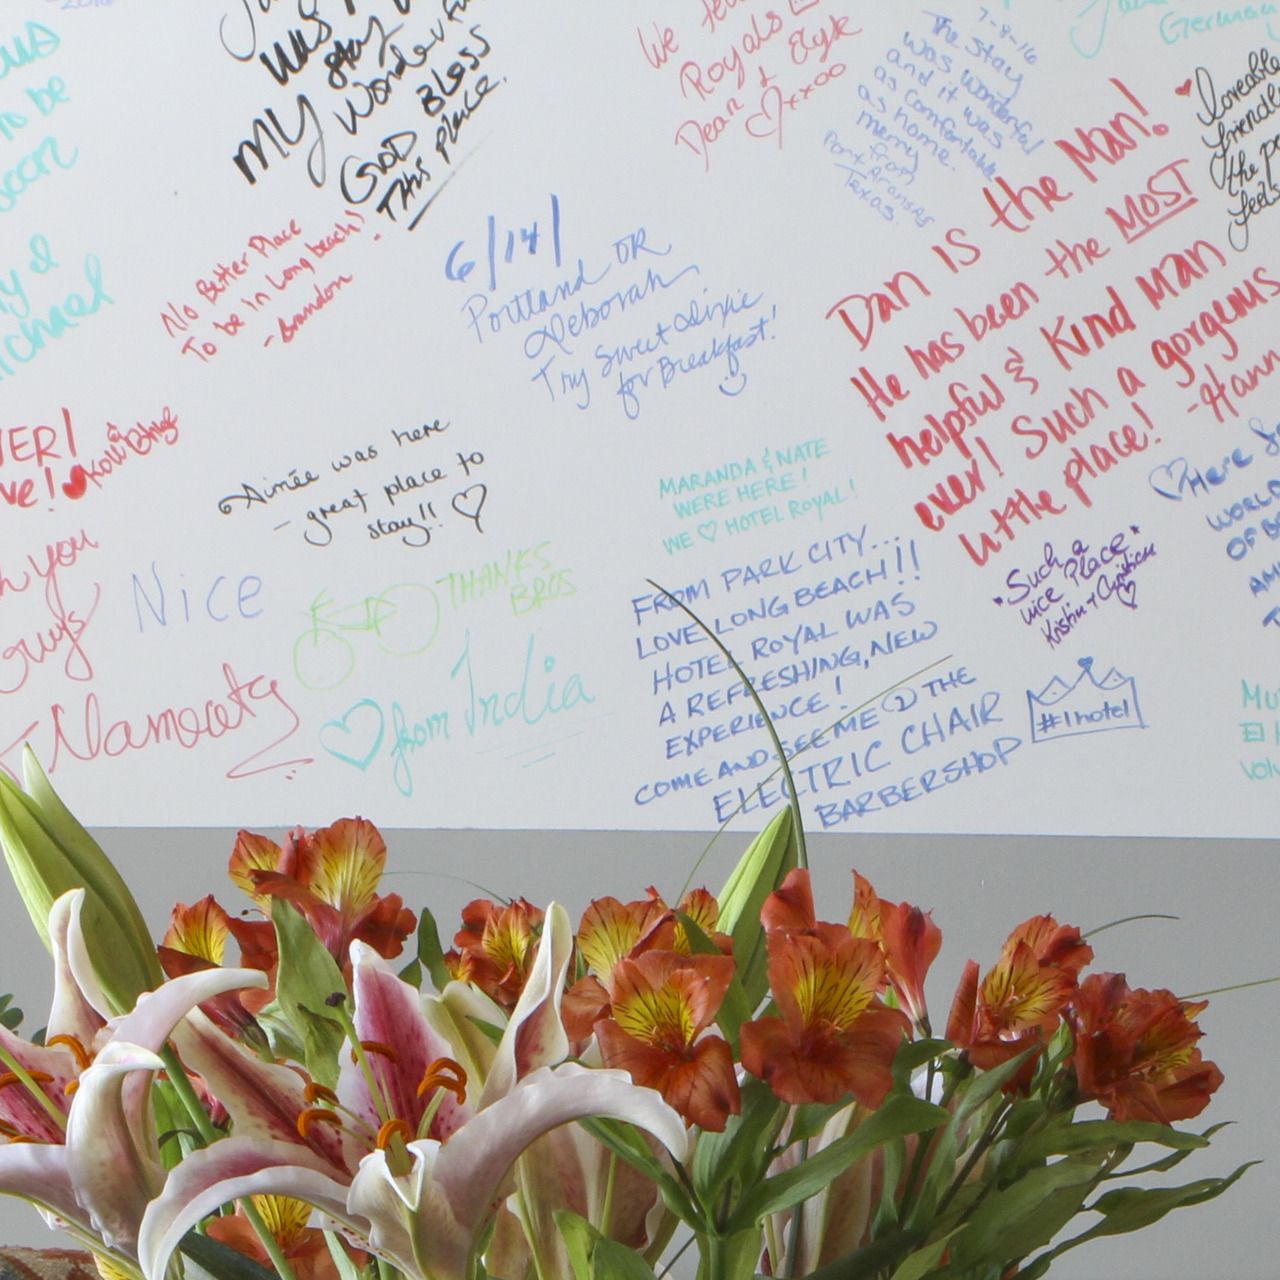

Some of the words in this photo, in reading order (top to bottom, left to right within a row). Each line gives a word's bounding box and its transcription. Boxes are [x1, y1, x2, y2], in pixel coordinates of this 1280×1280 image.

[827, 269, 931, 352] Dan
[983, 174, 1072, 232] the
[1053, 77, 1169, 182] Man!
[160, 302, 199, 338] No
[181, 336, 217, 362] To
[212, 313, 245, 336] be
[851, 365, 910, 422] He
[904, 329, 965, 380] has
[954, 282, 1040, 341] been
[1045, 234, 1111, 280] the
[531, 355, 590, 410] Try
[617, 367, 653, 420] for
[331, 446, 378, 473] was
[392, 418, 450, 446] here
[886, 372, 1006, 471] helpful
[914, 438, 1004, 532] ever!
[1117, 365, 1145, 398] a
[1064, 401, 1162, 508] place!
[304, 488, 368, 546] great
[384, 467, 448, 505] place
[456, 452, 484, 476] to
[658, 457, 756, 499] MARANDA
[776, 437, 830, 470] NATE
[673, 488, 730, 520] WERE
[663, 531, 693, 555] WE
[725, 509, 784, 535] HOTEL
[29, 529, 100, 619] you
[132, 561, 263, 633] Nice
[435, 541, 552, 608] THANKS
[631, 579, 710, 626] FROM
[720, 551, 803, 592] PARK
[636, 621, 708, 660] LOVE
[714, 597, 790, 637] LONG
[846, 592, 915, 629] WAS
[659, 702, 676, 727] A
[870, 621, 938, 662] NEW
[390, 701, 449, 797] from
[450, 628, 596, 736] India
[634, 768, 714, 806] COME
[833, 707, 880, 738] ME
[921, 666, 977, 697] THE
[901, 691, 1004, 755] CHAIR
[814, 735, 1022, 831] BARBERSHOP
